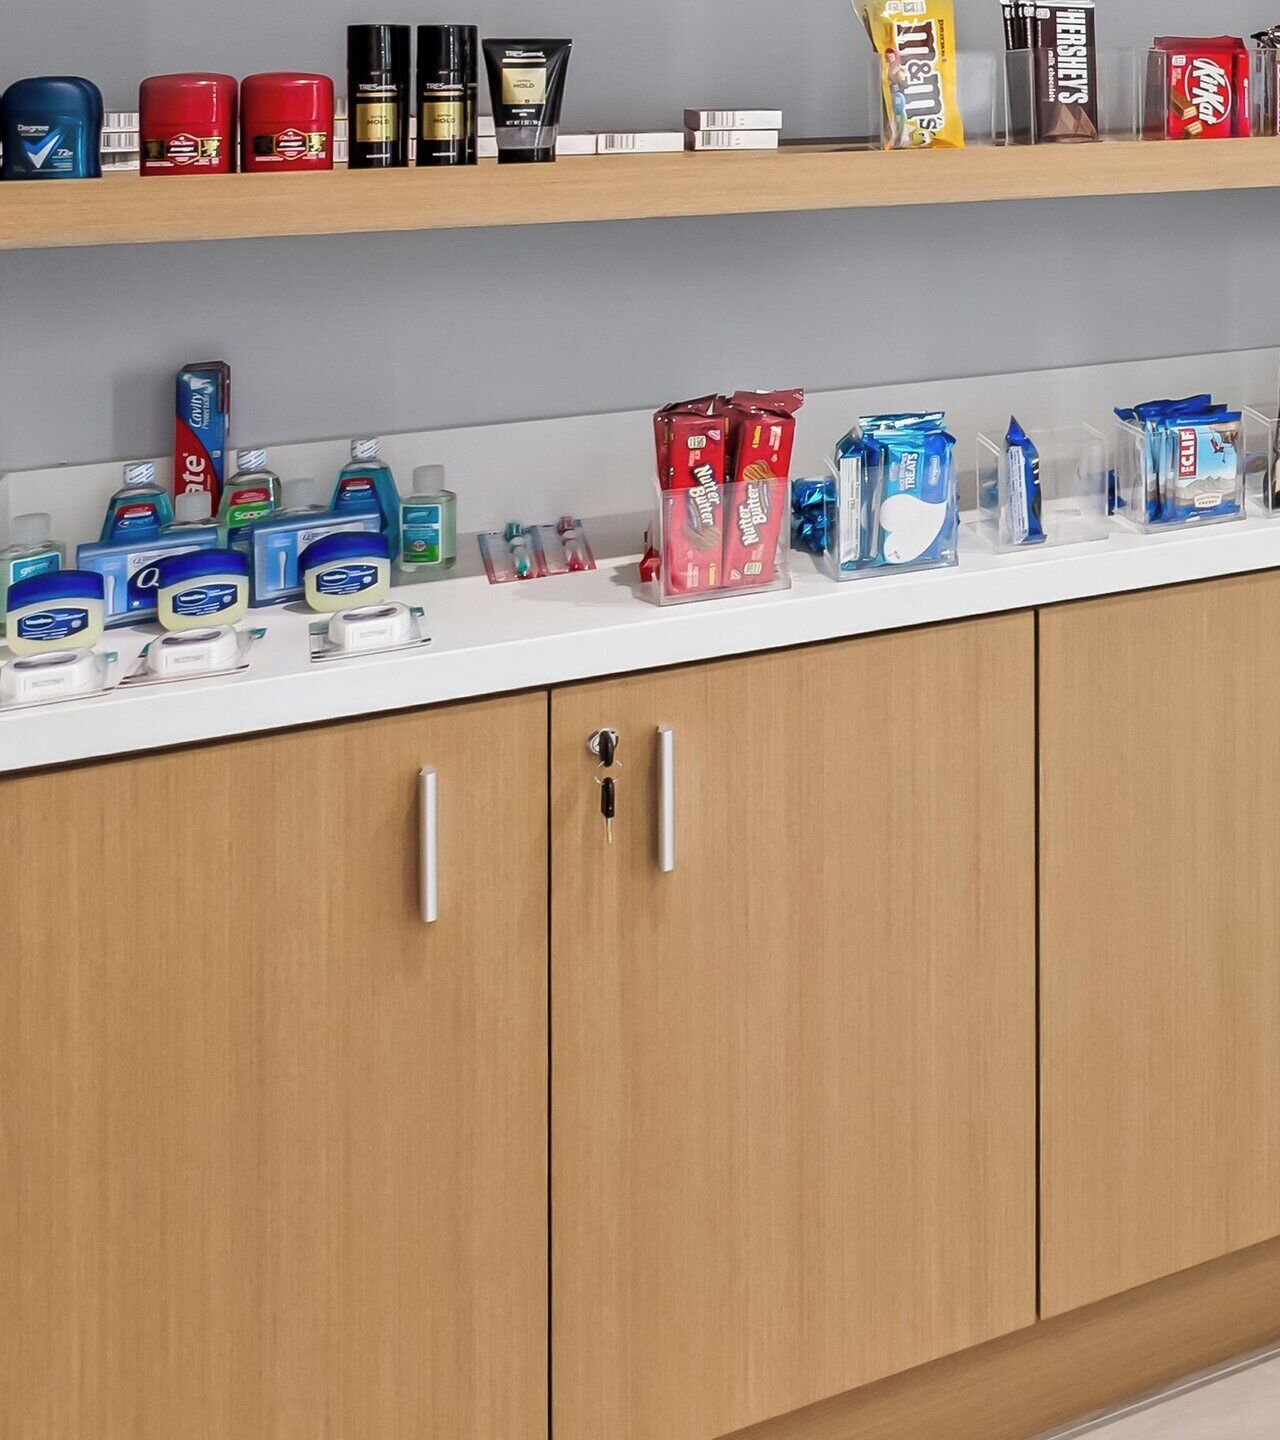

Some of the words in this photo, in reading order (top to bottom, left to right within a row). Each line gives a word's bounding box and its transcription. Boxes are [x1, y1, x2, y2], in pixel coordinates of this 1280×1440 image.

[1056, 10, 1089, 105] HERSHEY'S
[189, 392, 206, 428] Cavity
[693, 465, 720, 505] Nutter
[748, 484, 768, 526] Butter
[689, 487, 714, 526] Butter
[739, 506, 760, 546] Nutter
